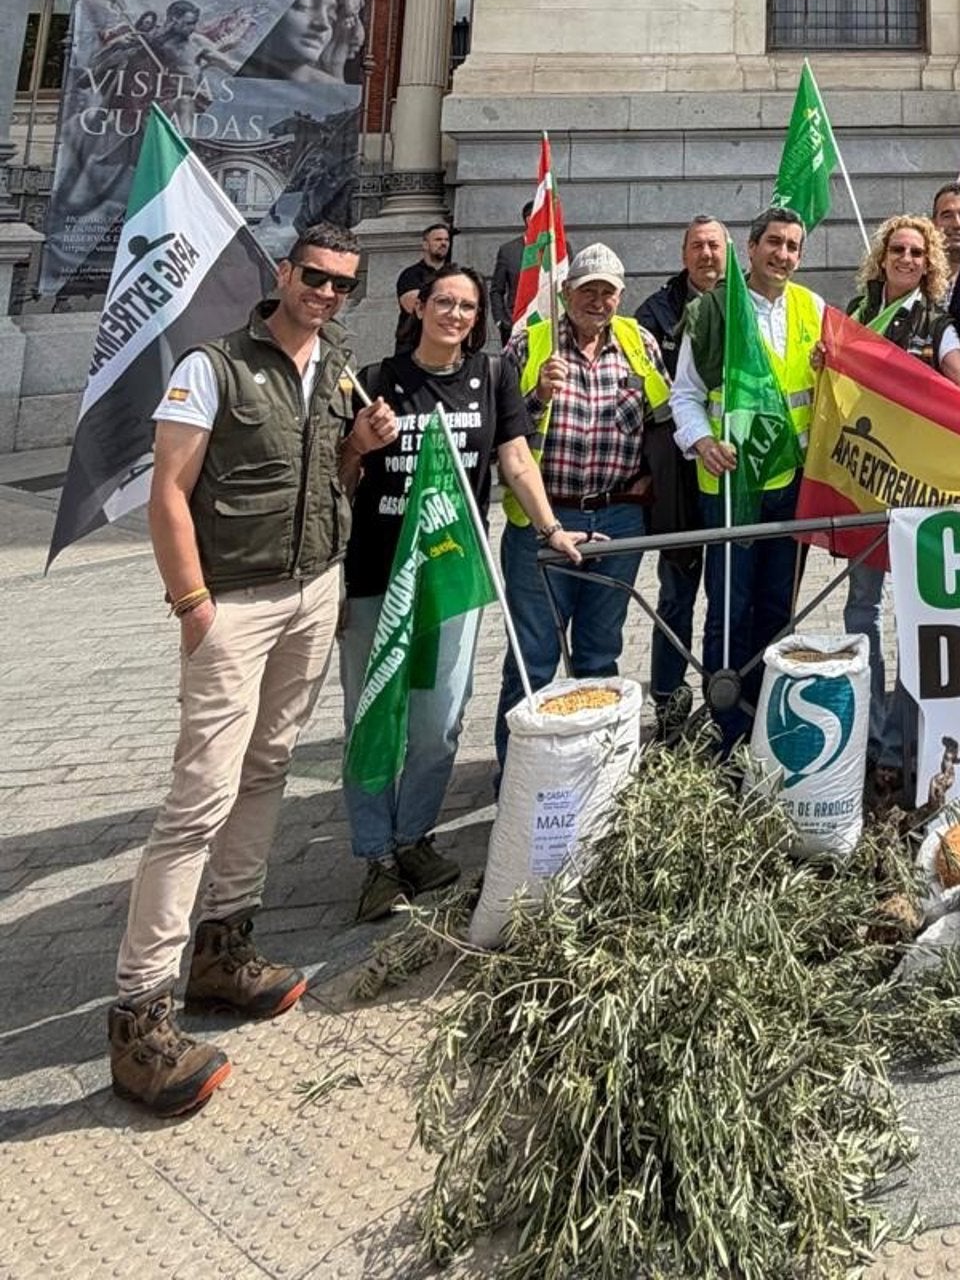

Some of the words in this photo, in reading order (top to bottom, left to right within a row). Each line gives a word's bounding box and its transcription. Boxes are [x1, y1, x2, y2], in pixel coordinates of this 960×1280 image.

[85, 68, 235, 104] VISITAS
[80, 106, 263, 141] GUADAS
[401, 434, 414, 452] EL
[798, 801, 811, 817] DE
